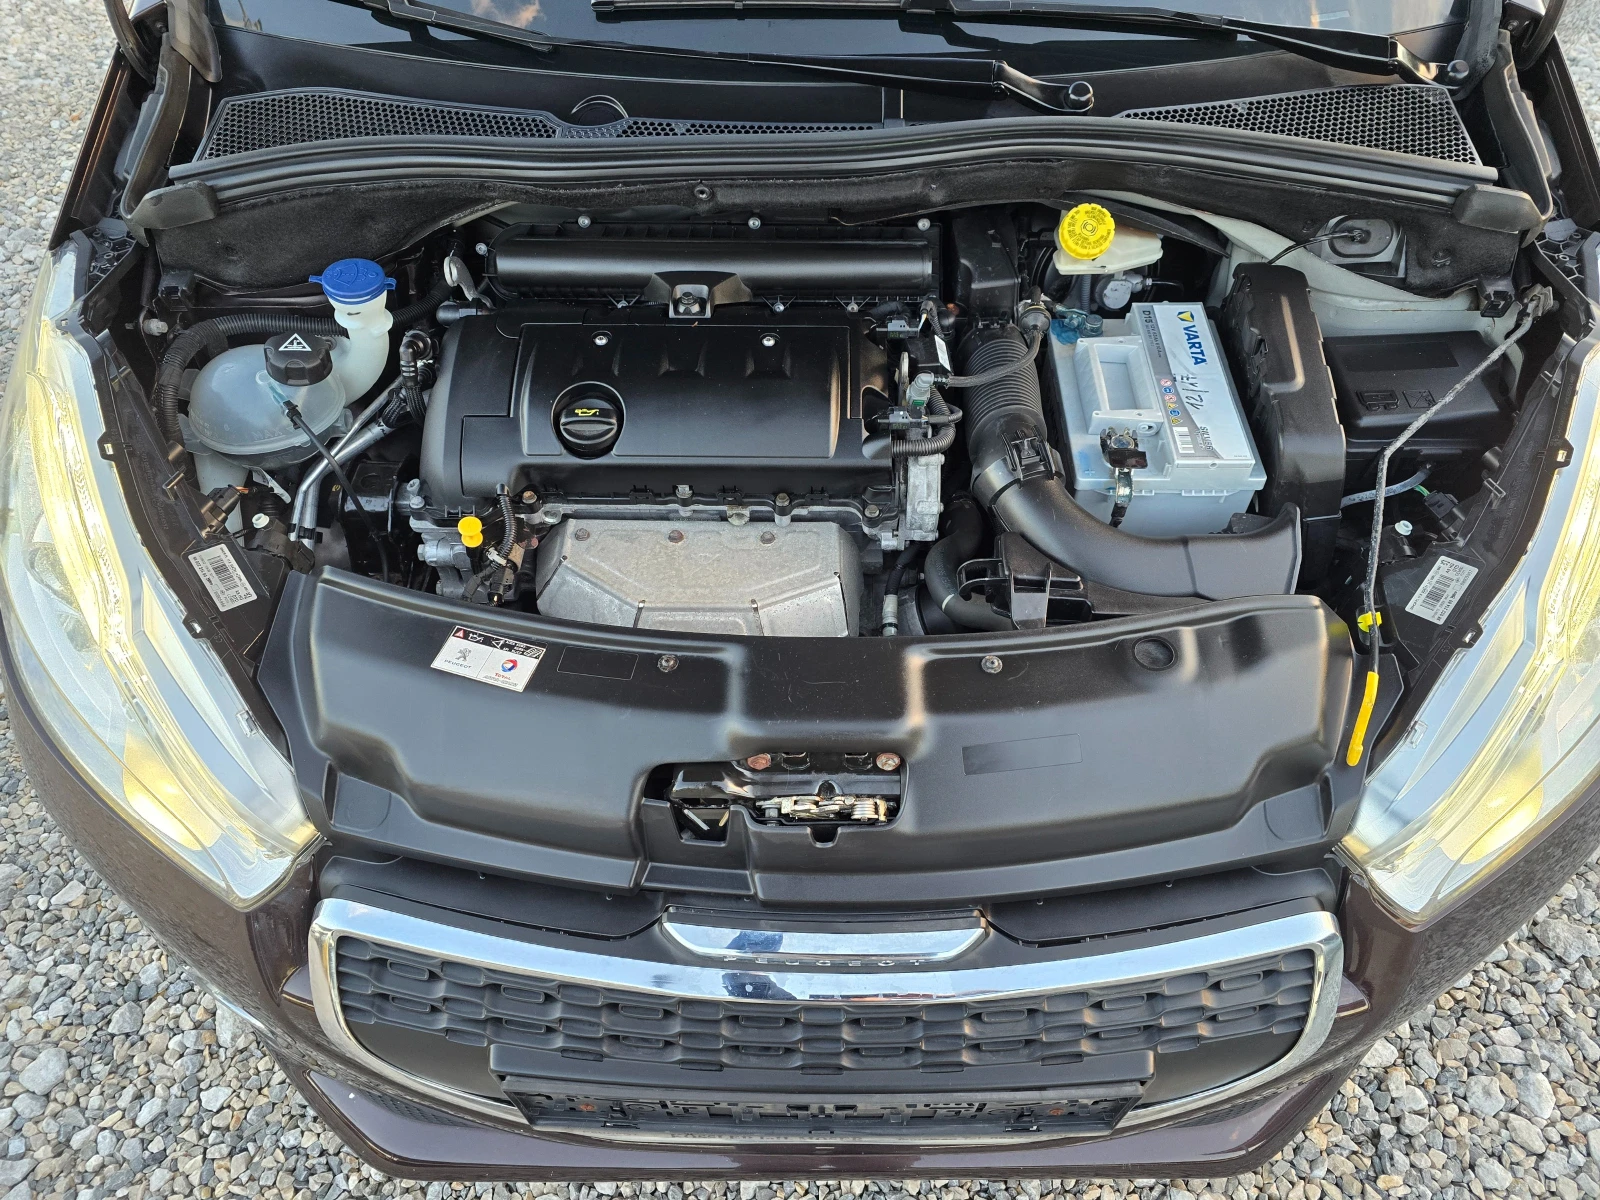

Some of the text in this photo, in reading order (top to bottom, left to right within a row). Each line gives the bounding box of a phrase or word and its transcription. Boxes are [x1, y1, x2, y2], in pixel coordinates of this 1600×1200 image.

[1142, 310, 1153, 324] D15
[1183, 325, 1207, 365] VARTA
[443, 659, 472, 669] PEUGEOT
[495, 672, 511, 680] TOTAL
